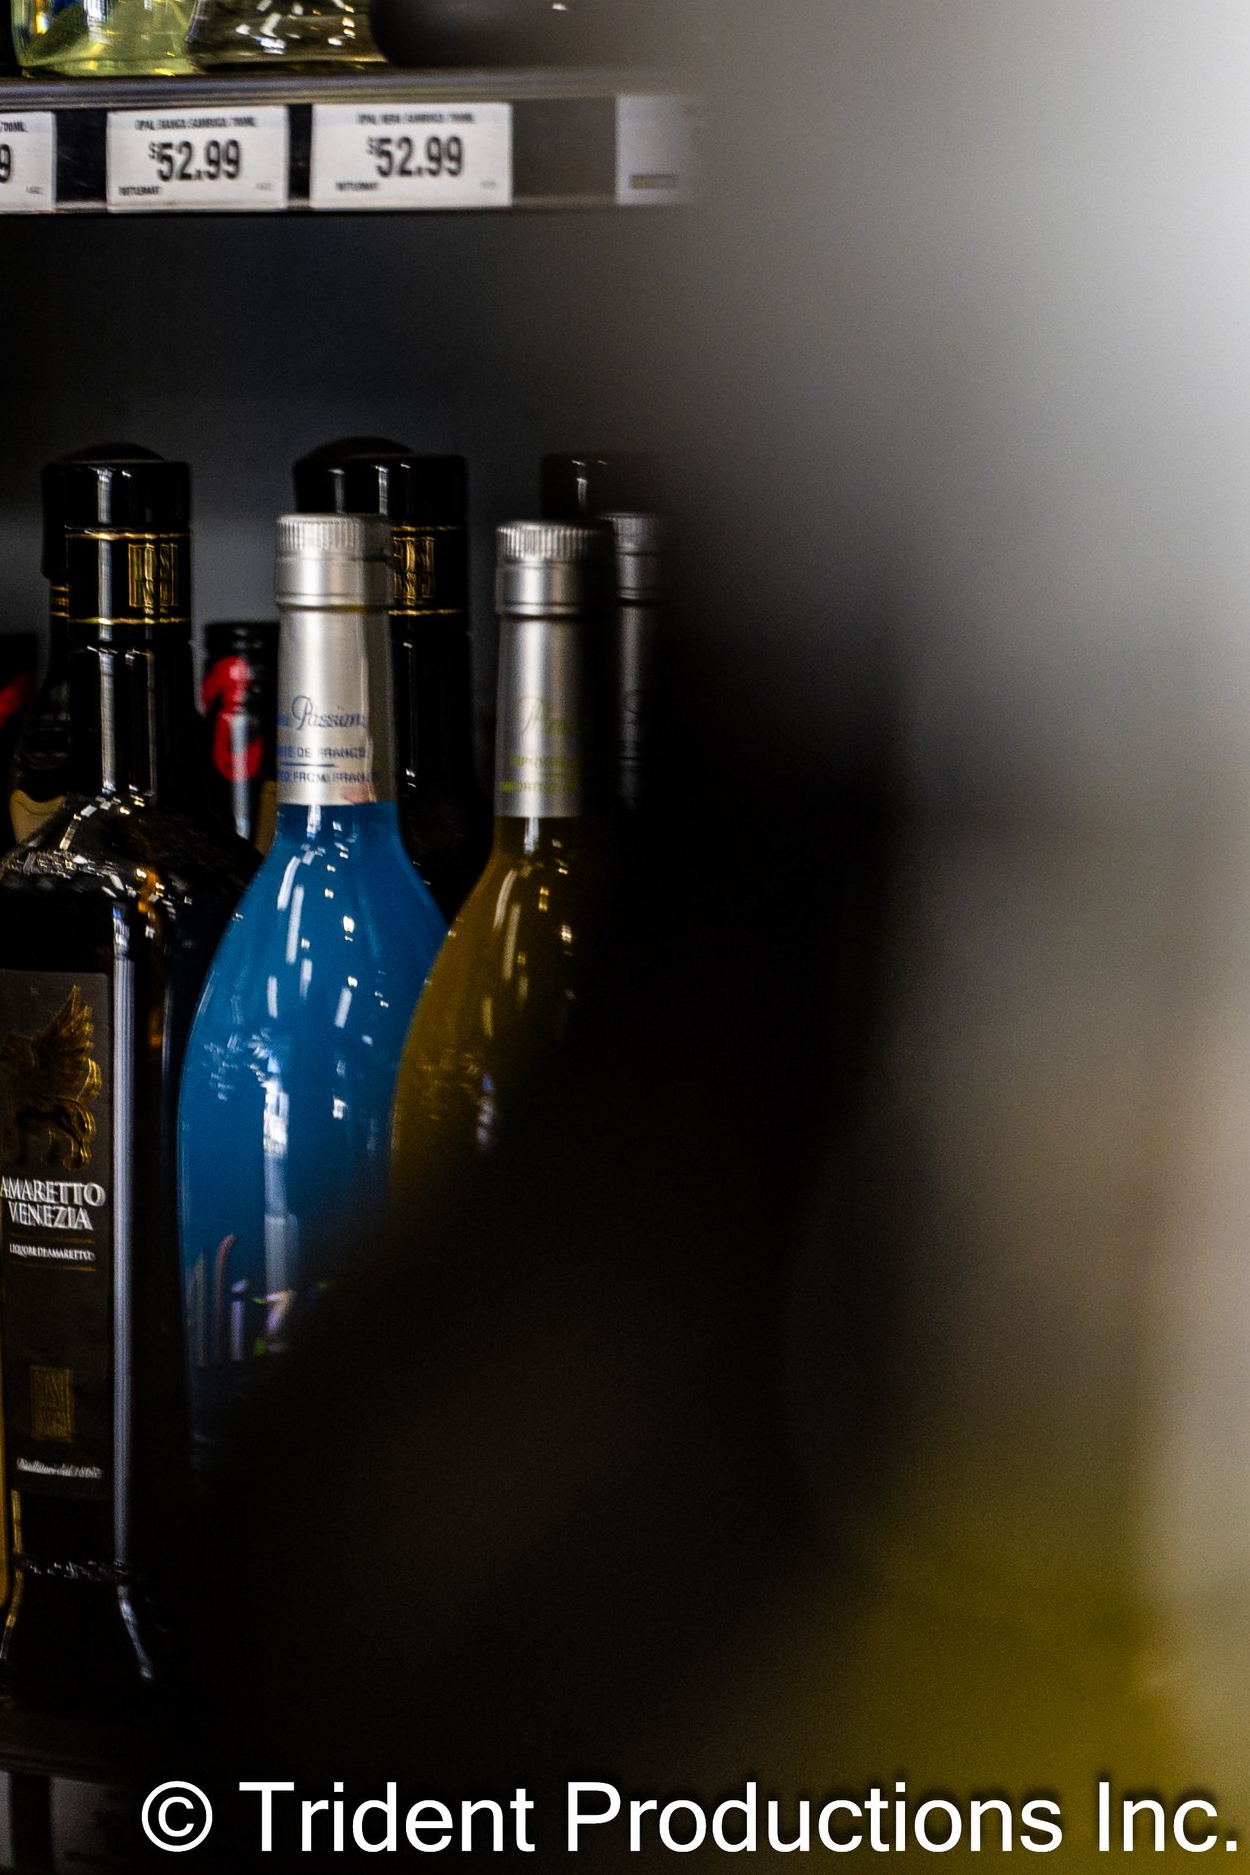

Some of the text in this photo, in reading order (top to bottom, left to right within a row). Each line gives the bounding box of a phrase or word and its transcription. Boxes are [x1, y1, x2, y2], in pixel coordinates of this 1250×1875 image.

[148, 138, 242, 183] $52.99
[366, 135, 465, 179] $52.99
[0, 1174, 107, 1207] AMARETTO
[7, 1200, 95, 1231] VENEZIA
